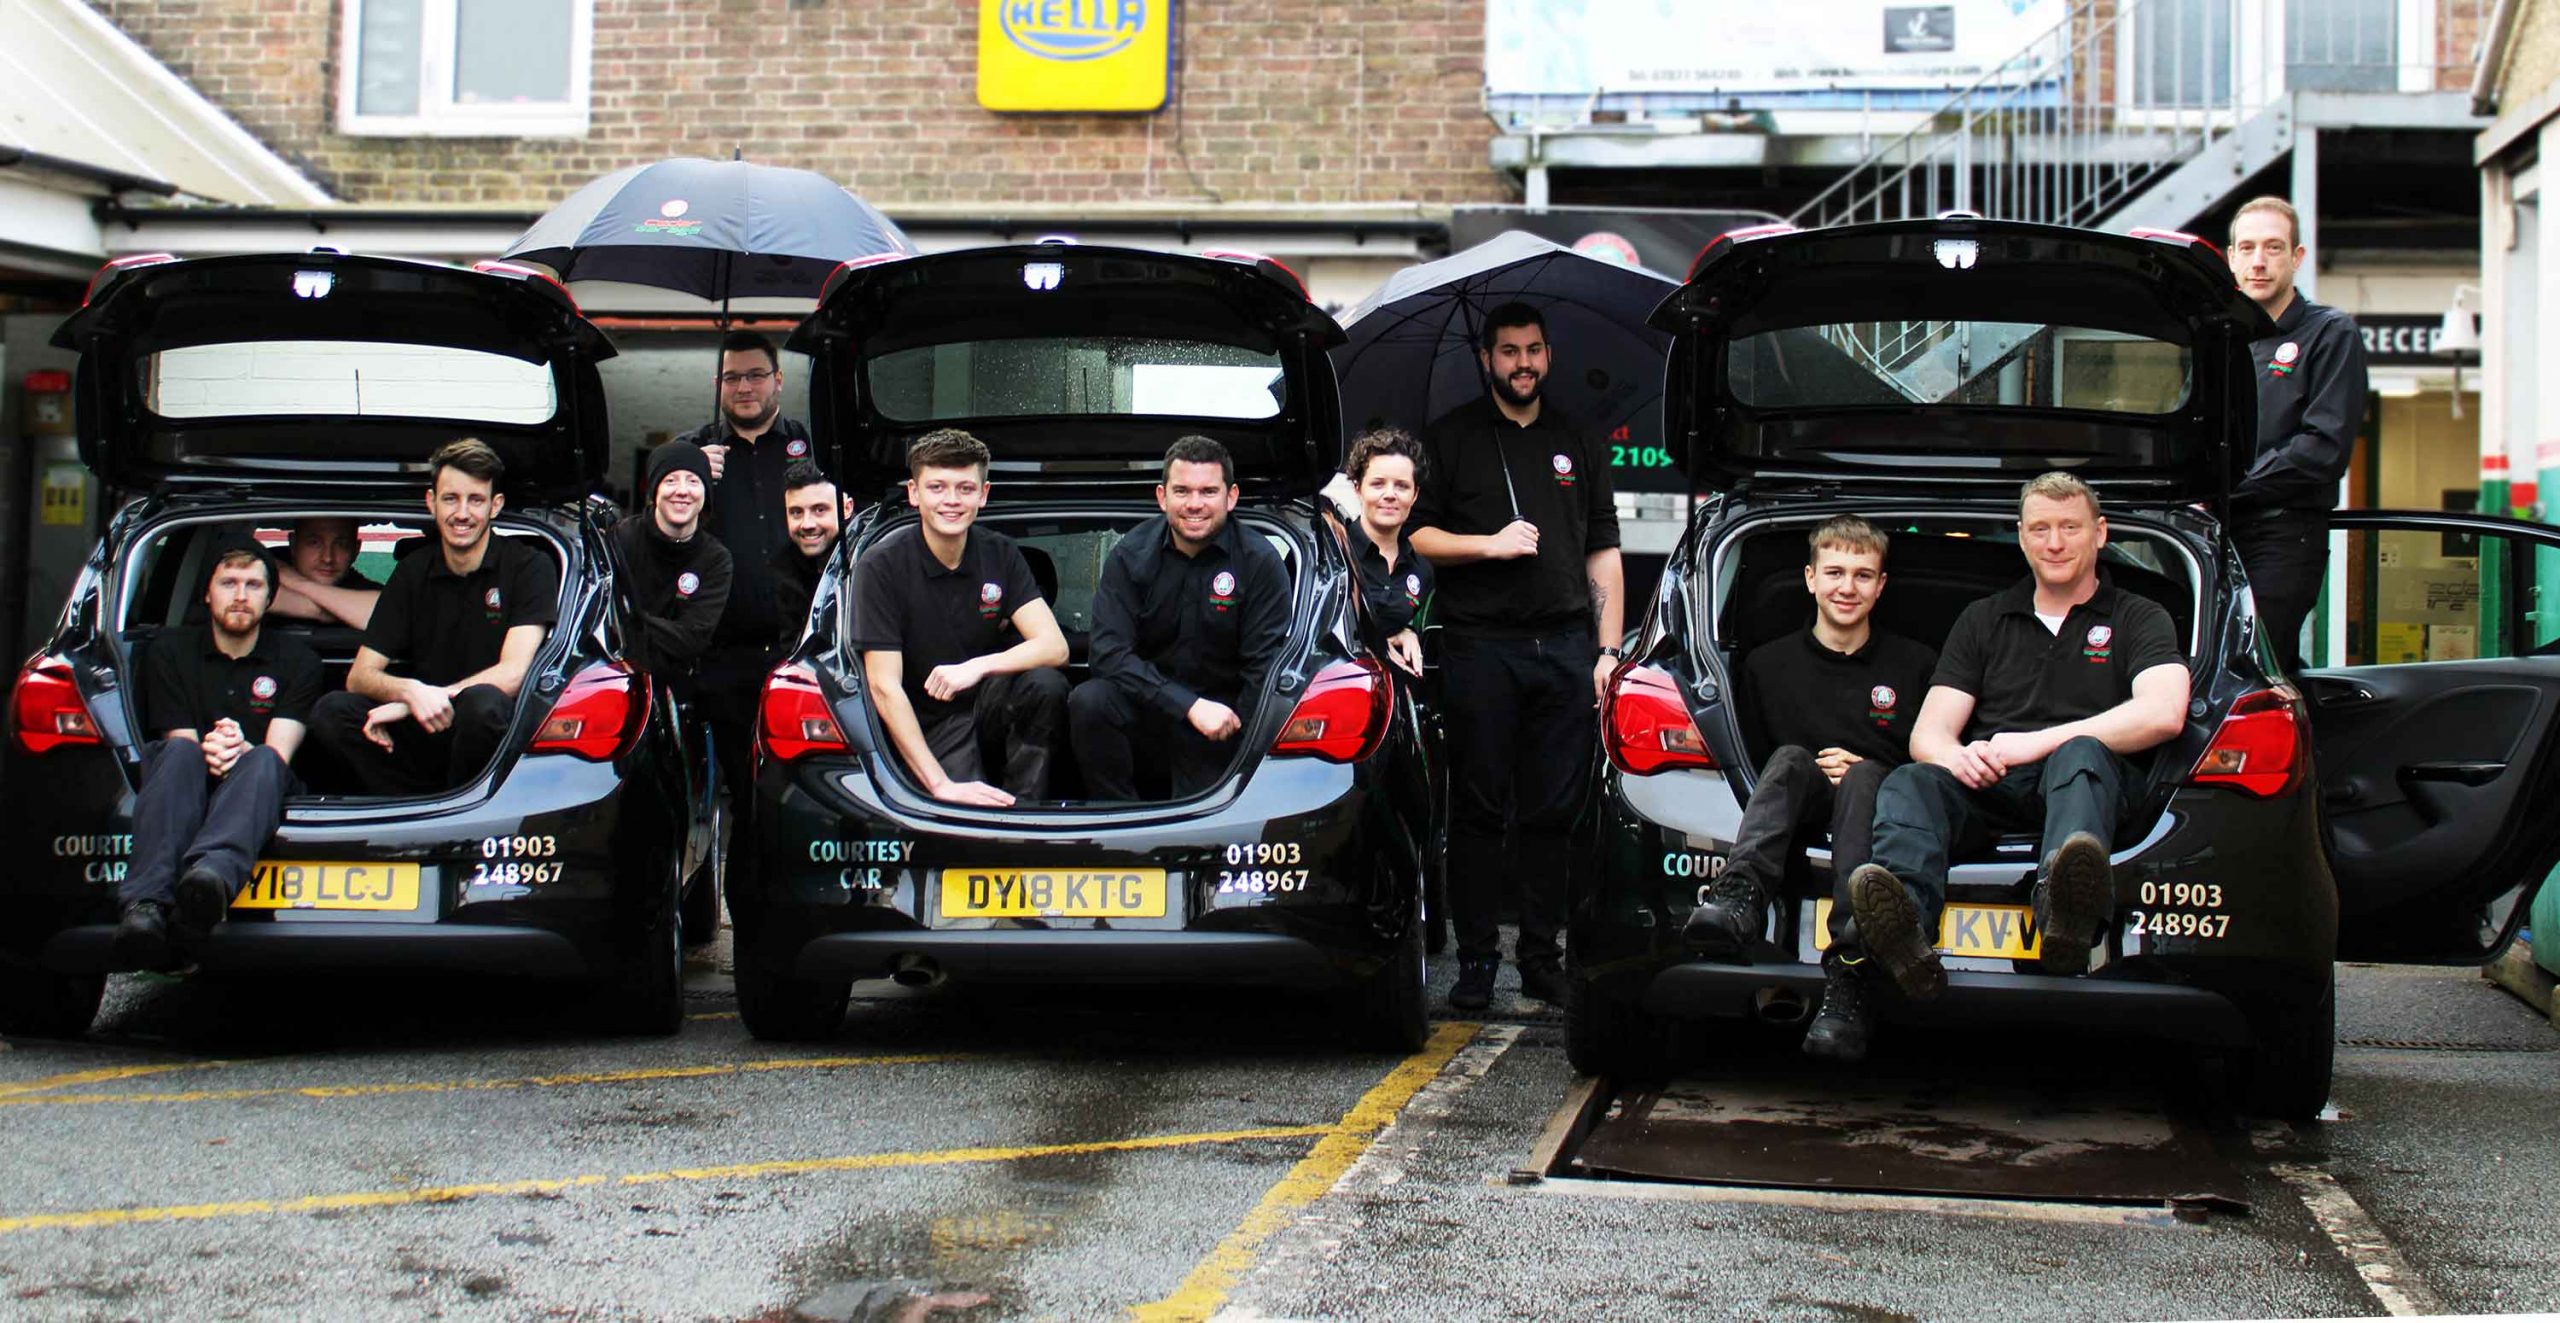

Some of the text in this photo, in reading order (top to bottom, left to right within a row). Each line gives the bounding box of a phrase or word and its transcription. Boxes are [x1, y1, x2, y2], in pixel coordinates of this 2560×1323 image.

[1012, 0, 1145, 33] HELLA
[53, 834, 134, 857] COURTE
[482, 835, 558, 859] 01903
[809, 840, 916, 862] COURTESY
[1226, 843, 1302, 866] 01903
[84, 861, 129, 883] CAR
[473, 861, 565, 886] 248967
[840, 867, 883, 890] CAR
[1663, 853, 1731, 880] COUR
[317, 867, 395, 902] LCJ
[967, 875, 1143, 910] DY18 KTG
[1219, 869, 1310, 894] 248967
[2140, 881, 2223, 908] 01903
[2129, 910, 2231, 939] 248967
